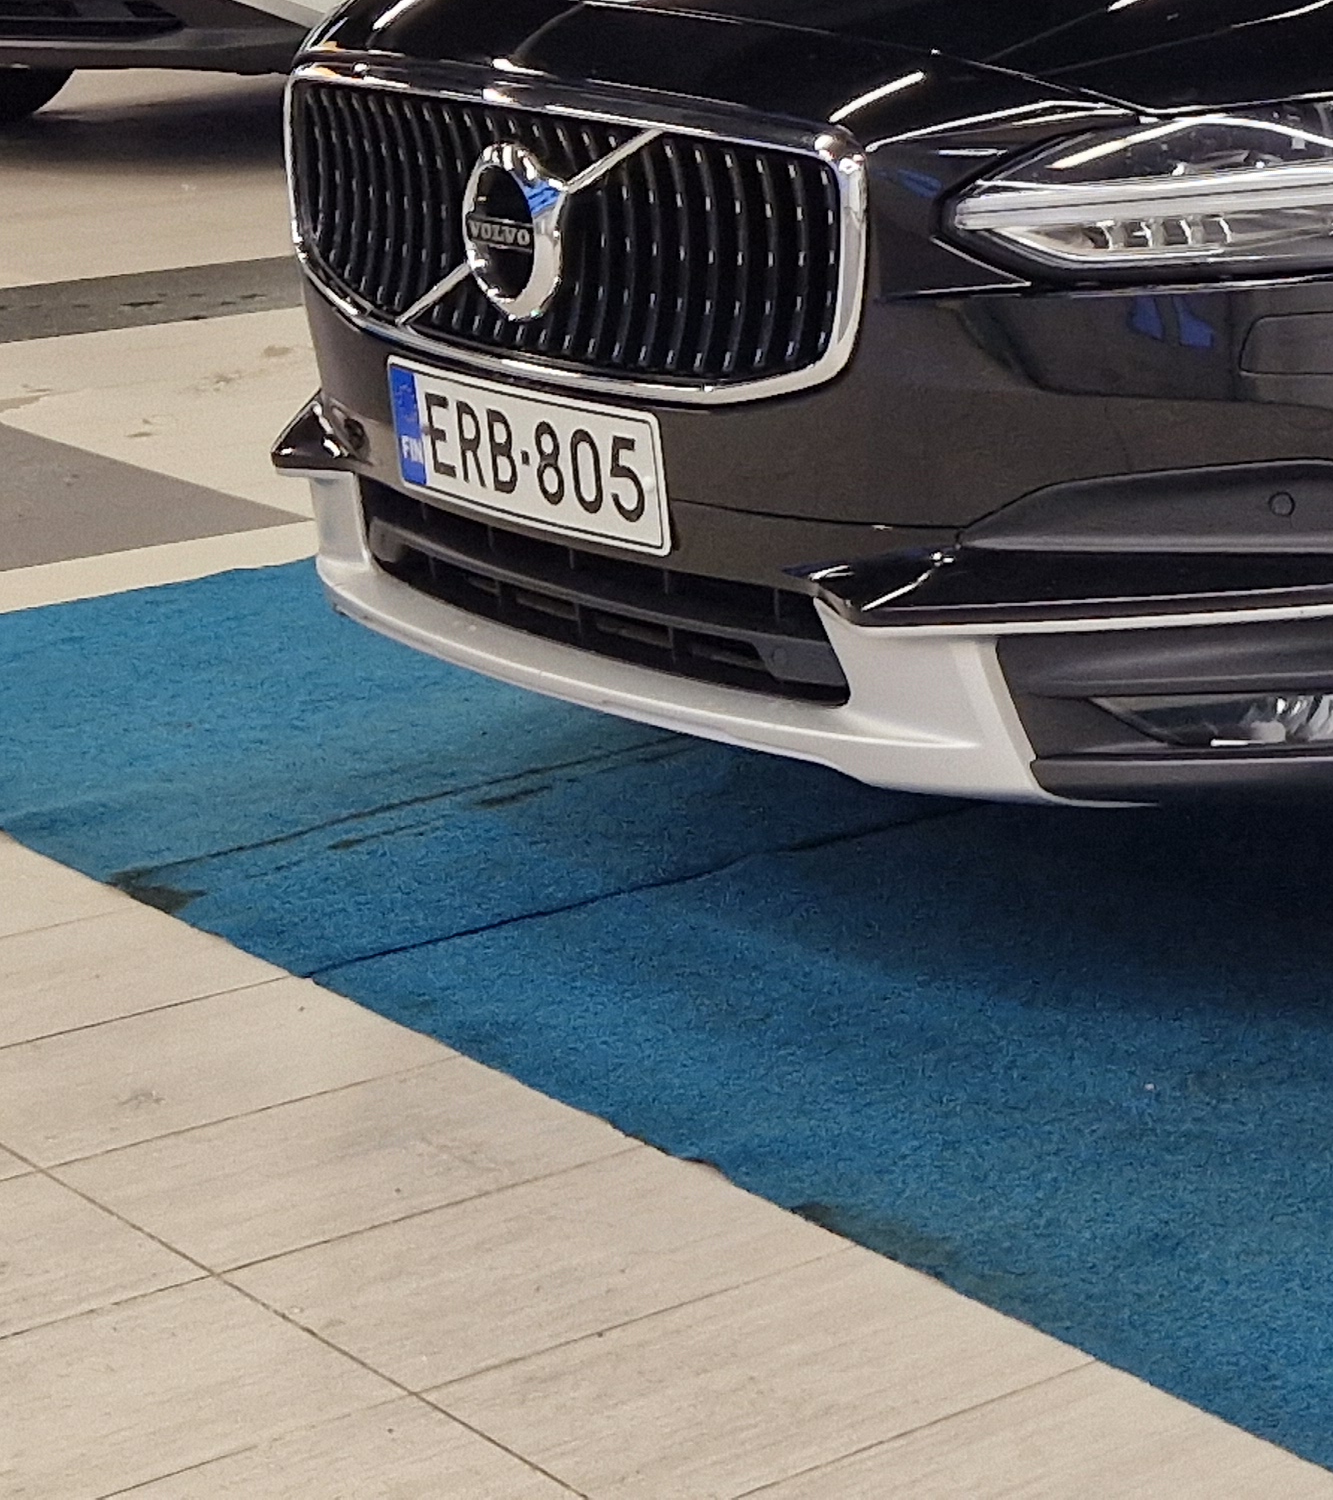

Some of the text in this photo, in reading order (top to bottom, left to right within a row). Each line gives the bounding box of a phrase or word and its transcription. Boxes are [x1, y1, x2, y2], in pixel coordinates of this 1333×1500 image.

[468, 220, 530, 246] VOLVO
[402, 436, 424, 463] FIN
[424, 392, 646, 523] ERB-805
